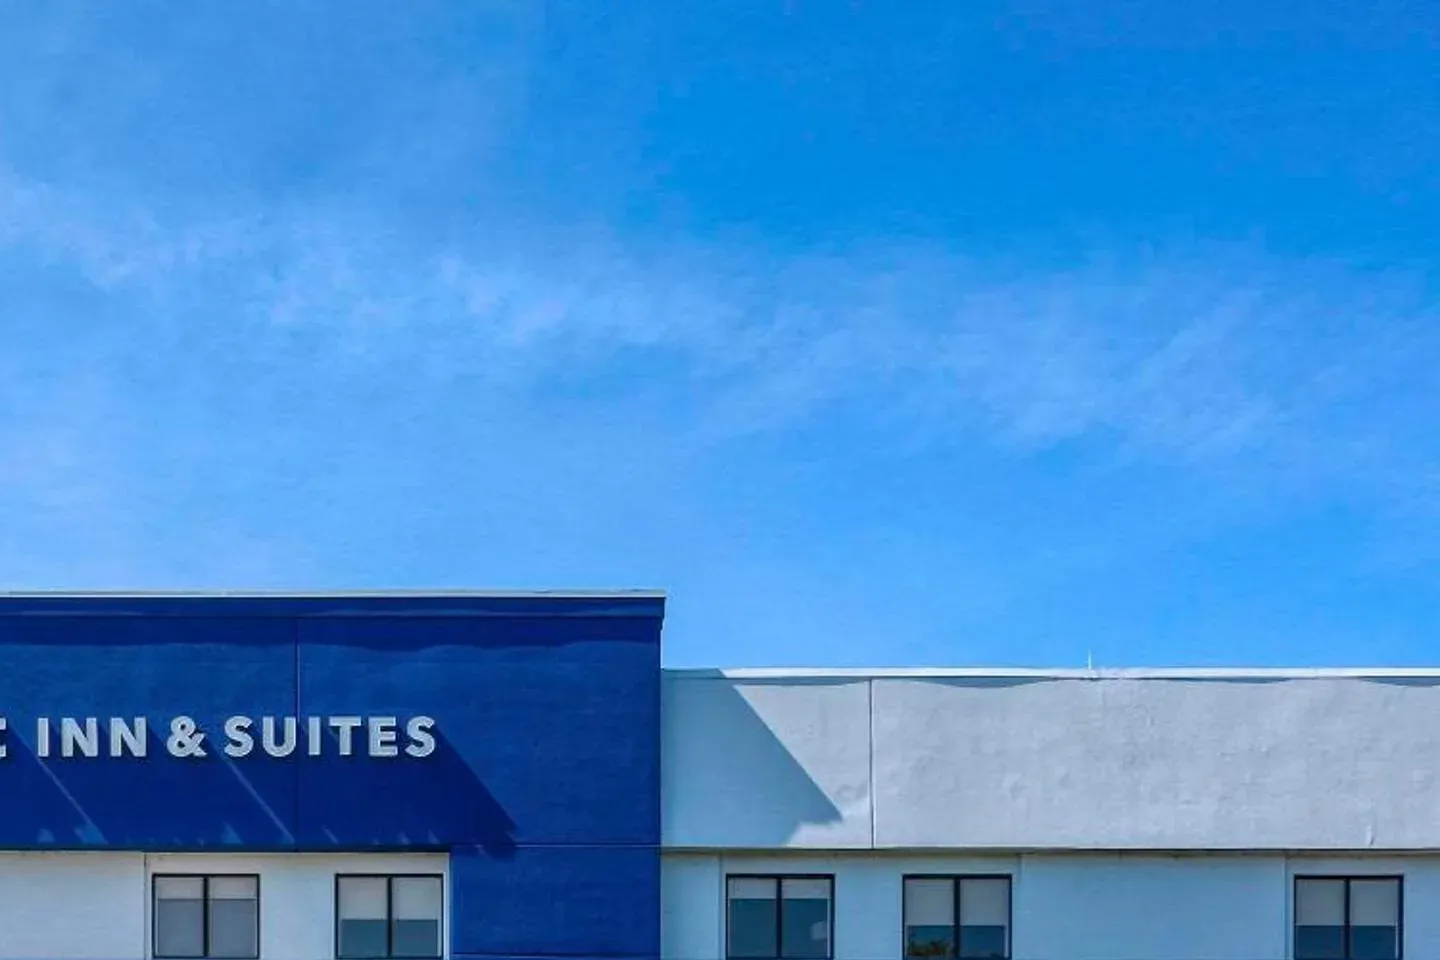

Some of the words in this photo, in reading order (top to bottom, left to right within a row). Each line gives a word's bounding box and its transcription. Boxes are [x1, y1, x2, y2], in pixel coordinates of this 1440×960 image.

[38, 717, 147, 758] INN
[167, 715, 208, 758] &
[224, 715, 436, 758] SUITES
